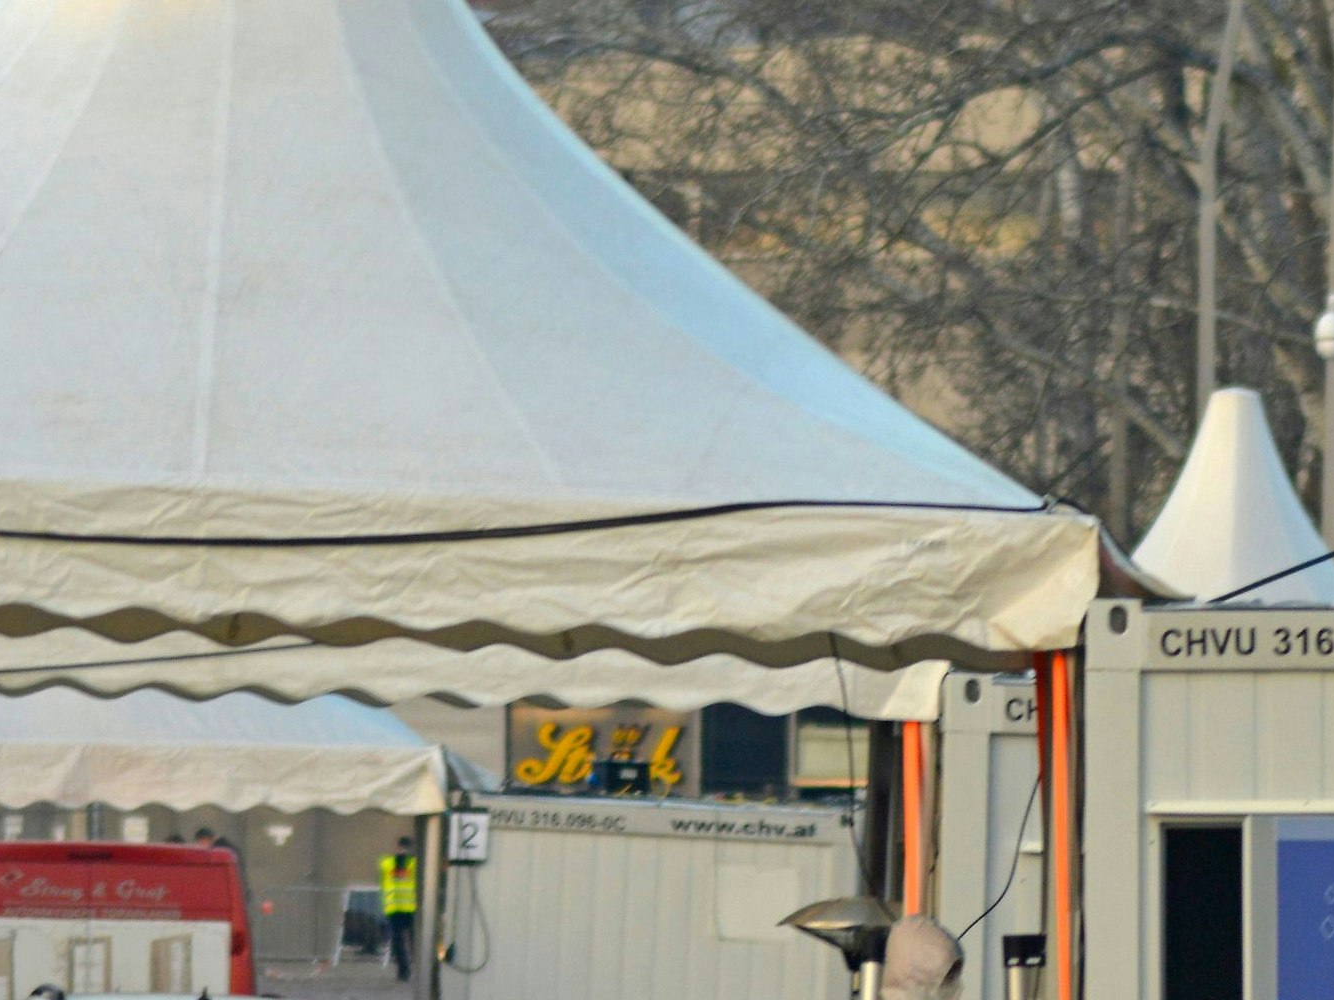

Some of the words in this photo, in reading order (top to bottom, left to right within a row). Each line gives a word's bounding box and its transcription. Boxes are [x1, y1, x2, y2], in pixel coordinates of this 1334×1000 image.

[1160, 627, 1257, 655] CHVU
[461, 821, 480, 849] 2
[671, 817, 816, 838] www.chv.at
